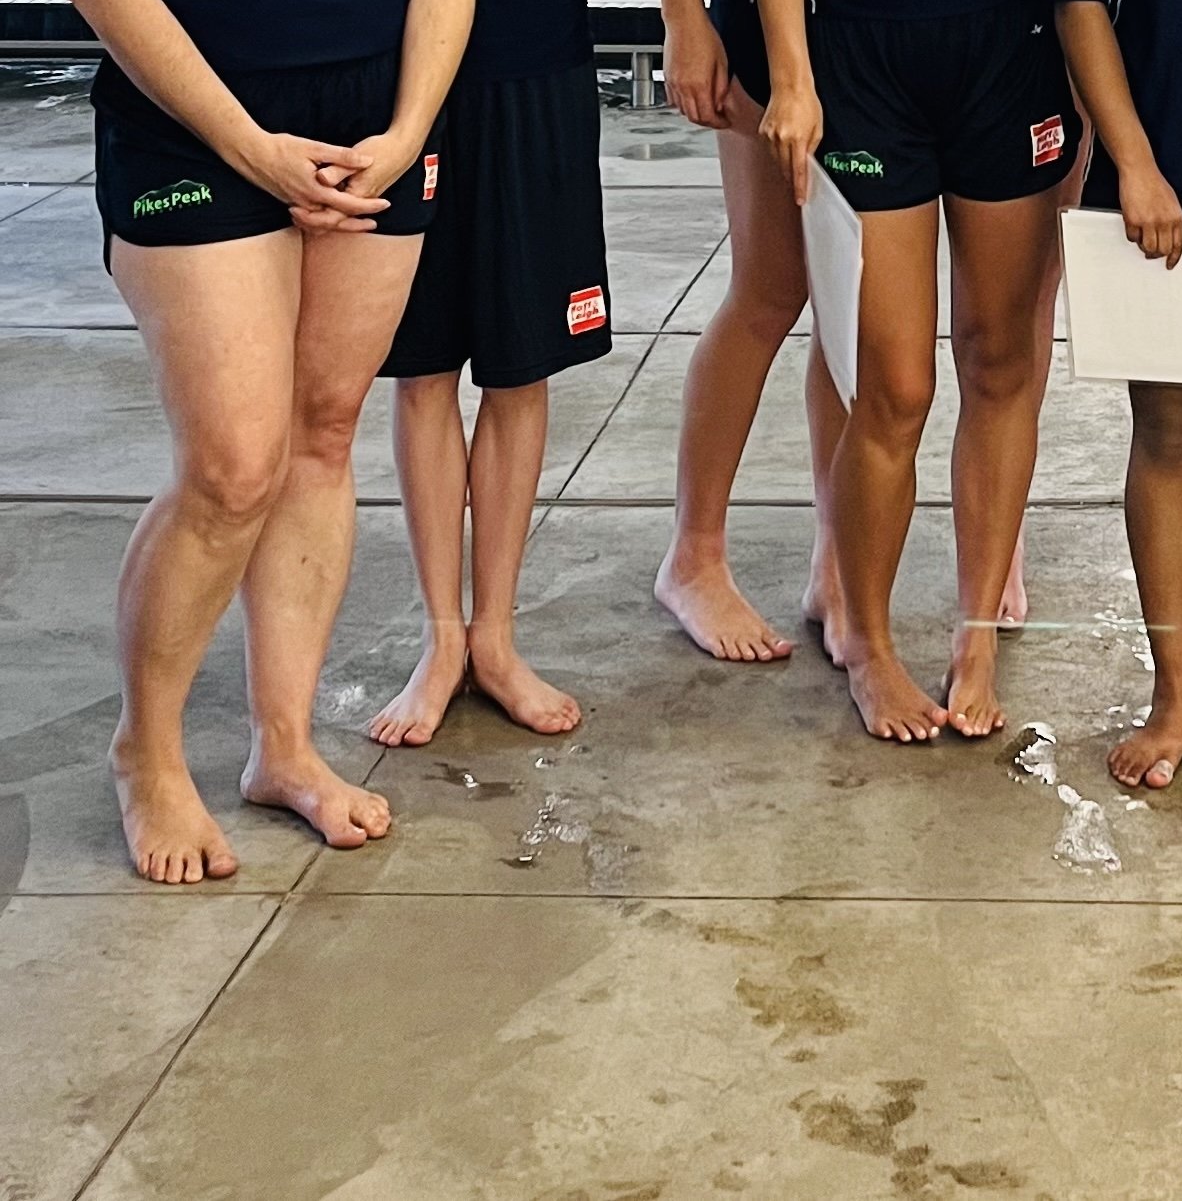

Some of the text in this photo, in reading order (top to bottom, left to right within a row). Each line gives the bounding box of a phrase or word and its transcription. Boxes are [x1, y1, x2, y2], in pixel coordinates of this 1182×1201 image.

[851, 159, 884, 175] Peak
[133, 197, 170, 216] Pikes
[172, 186, 212, 207] Peak
